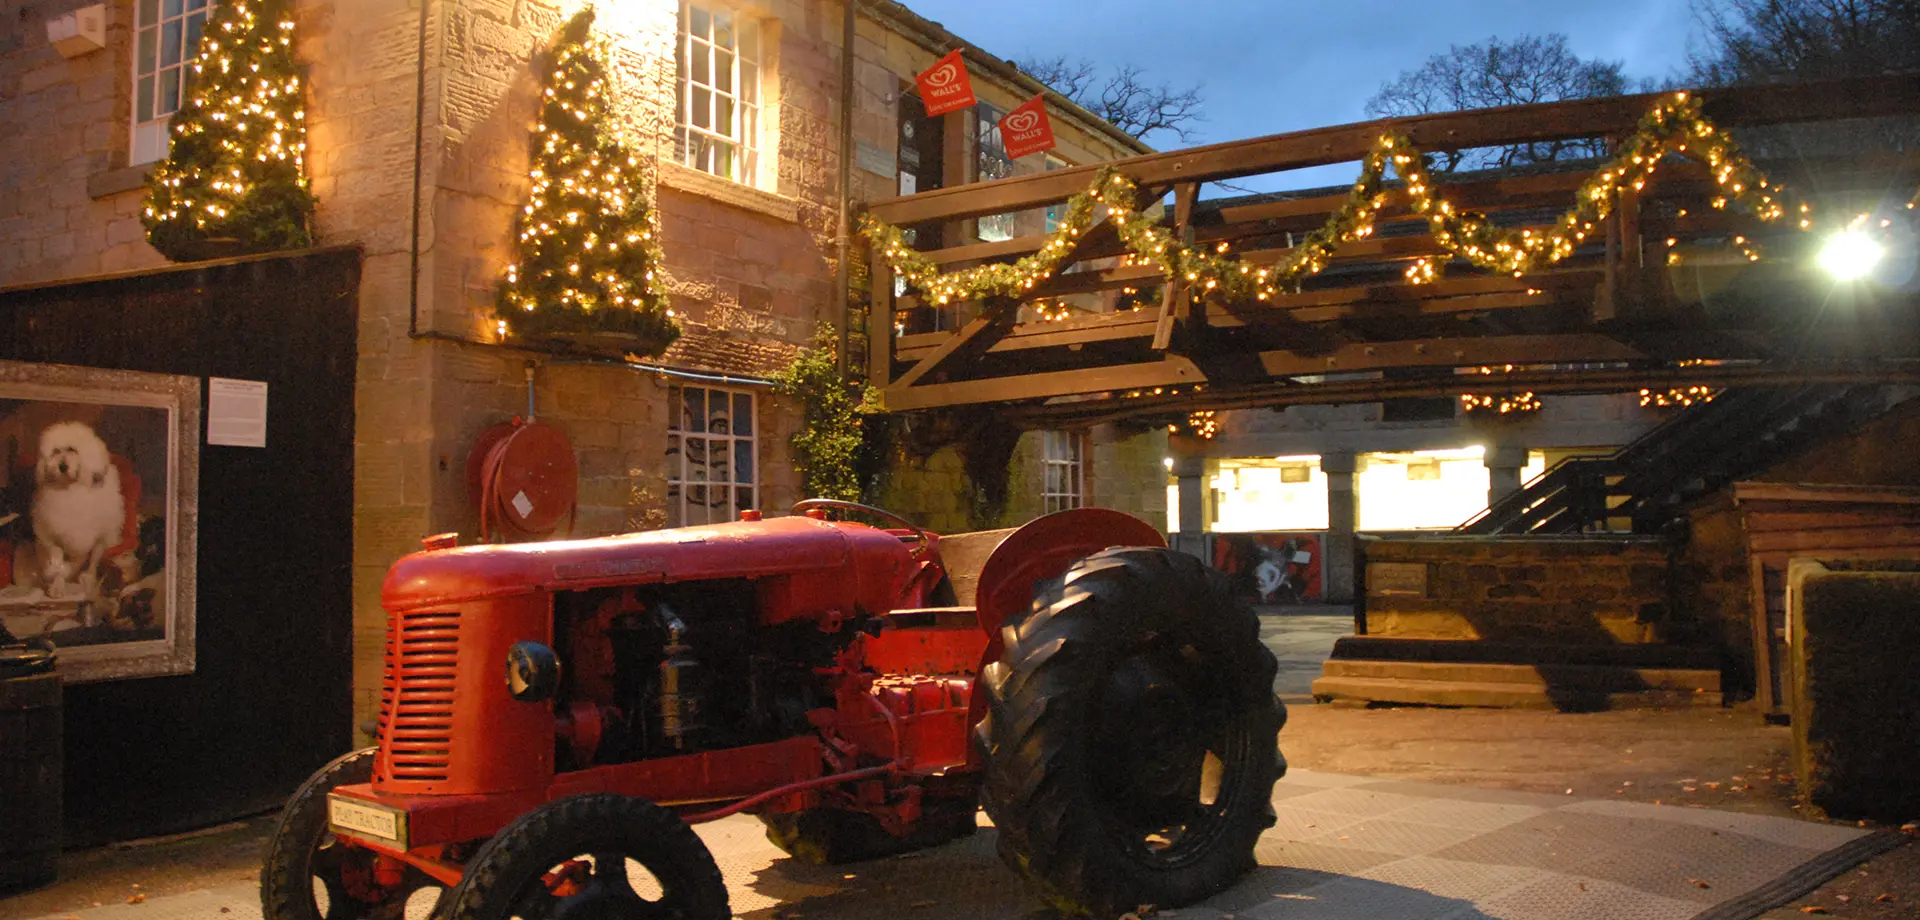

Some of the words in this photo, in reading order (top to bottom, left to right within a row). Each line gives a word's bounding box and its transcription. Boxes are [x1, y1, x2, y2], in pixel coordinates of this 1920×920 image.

[930, 83, 961, 97] WALL'S
[1012, 128, 1043, 141] WALL'S
[353, 810, 395, 834] TRACTOR
